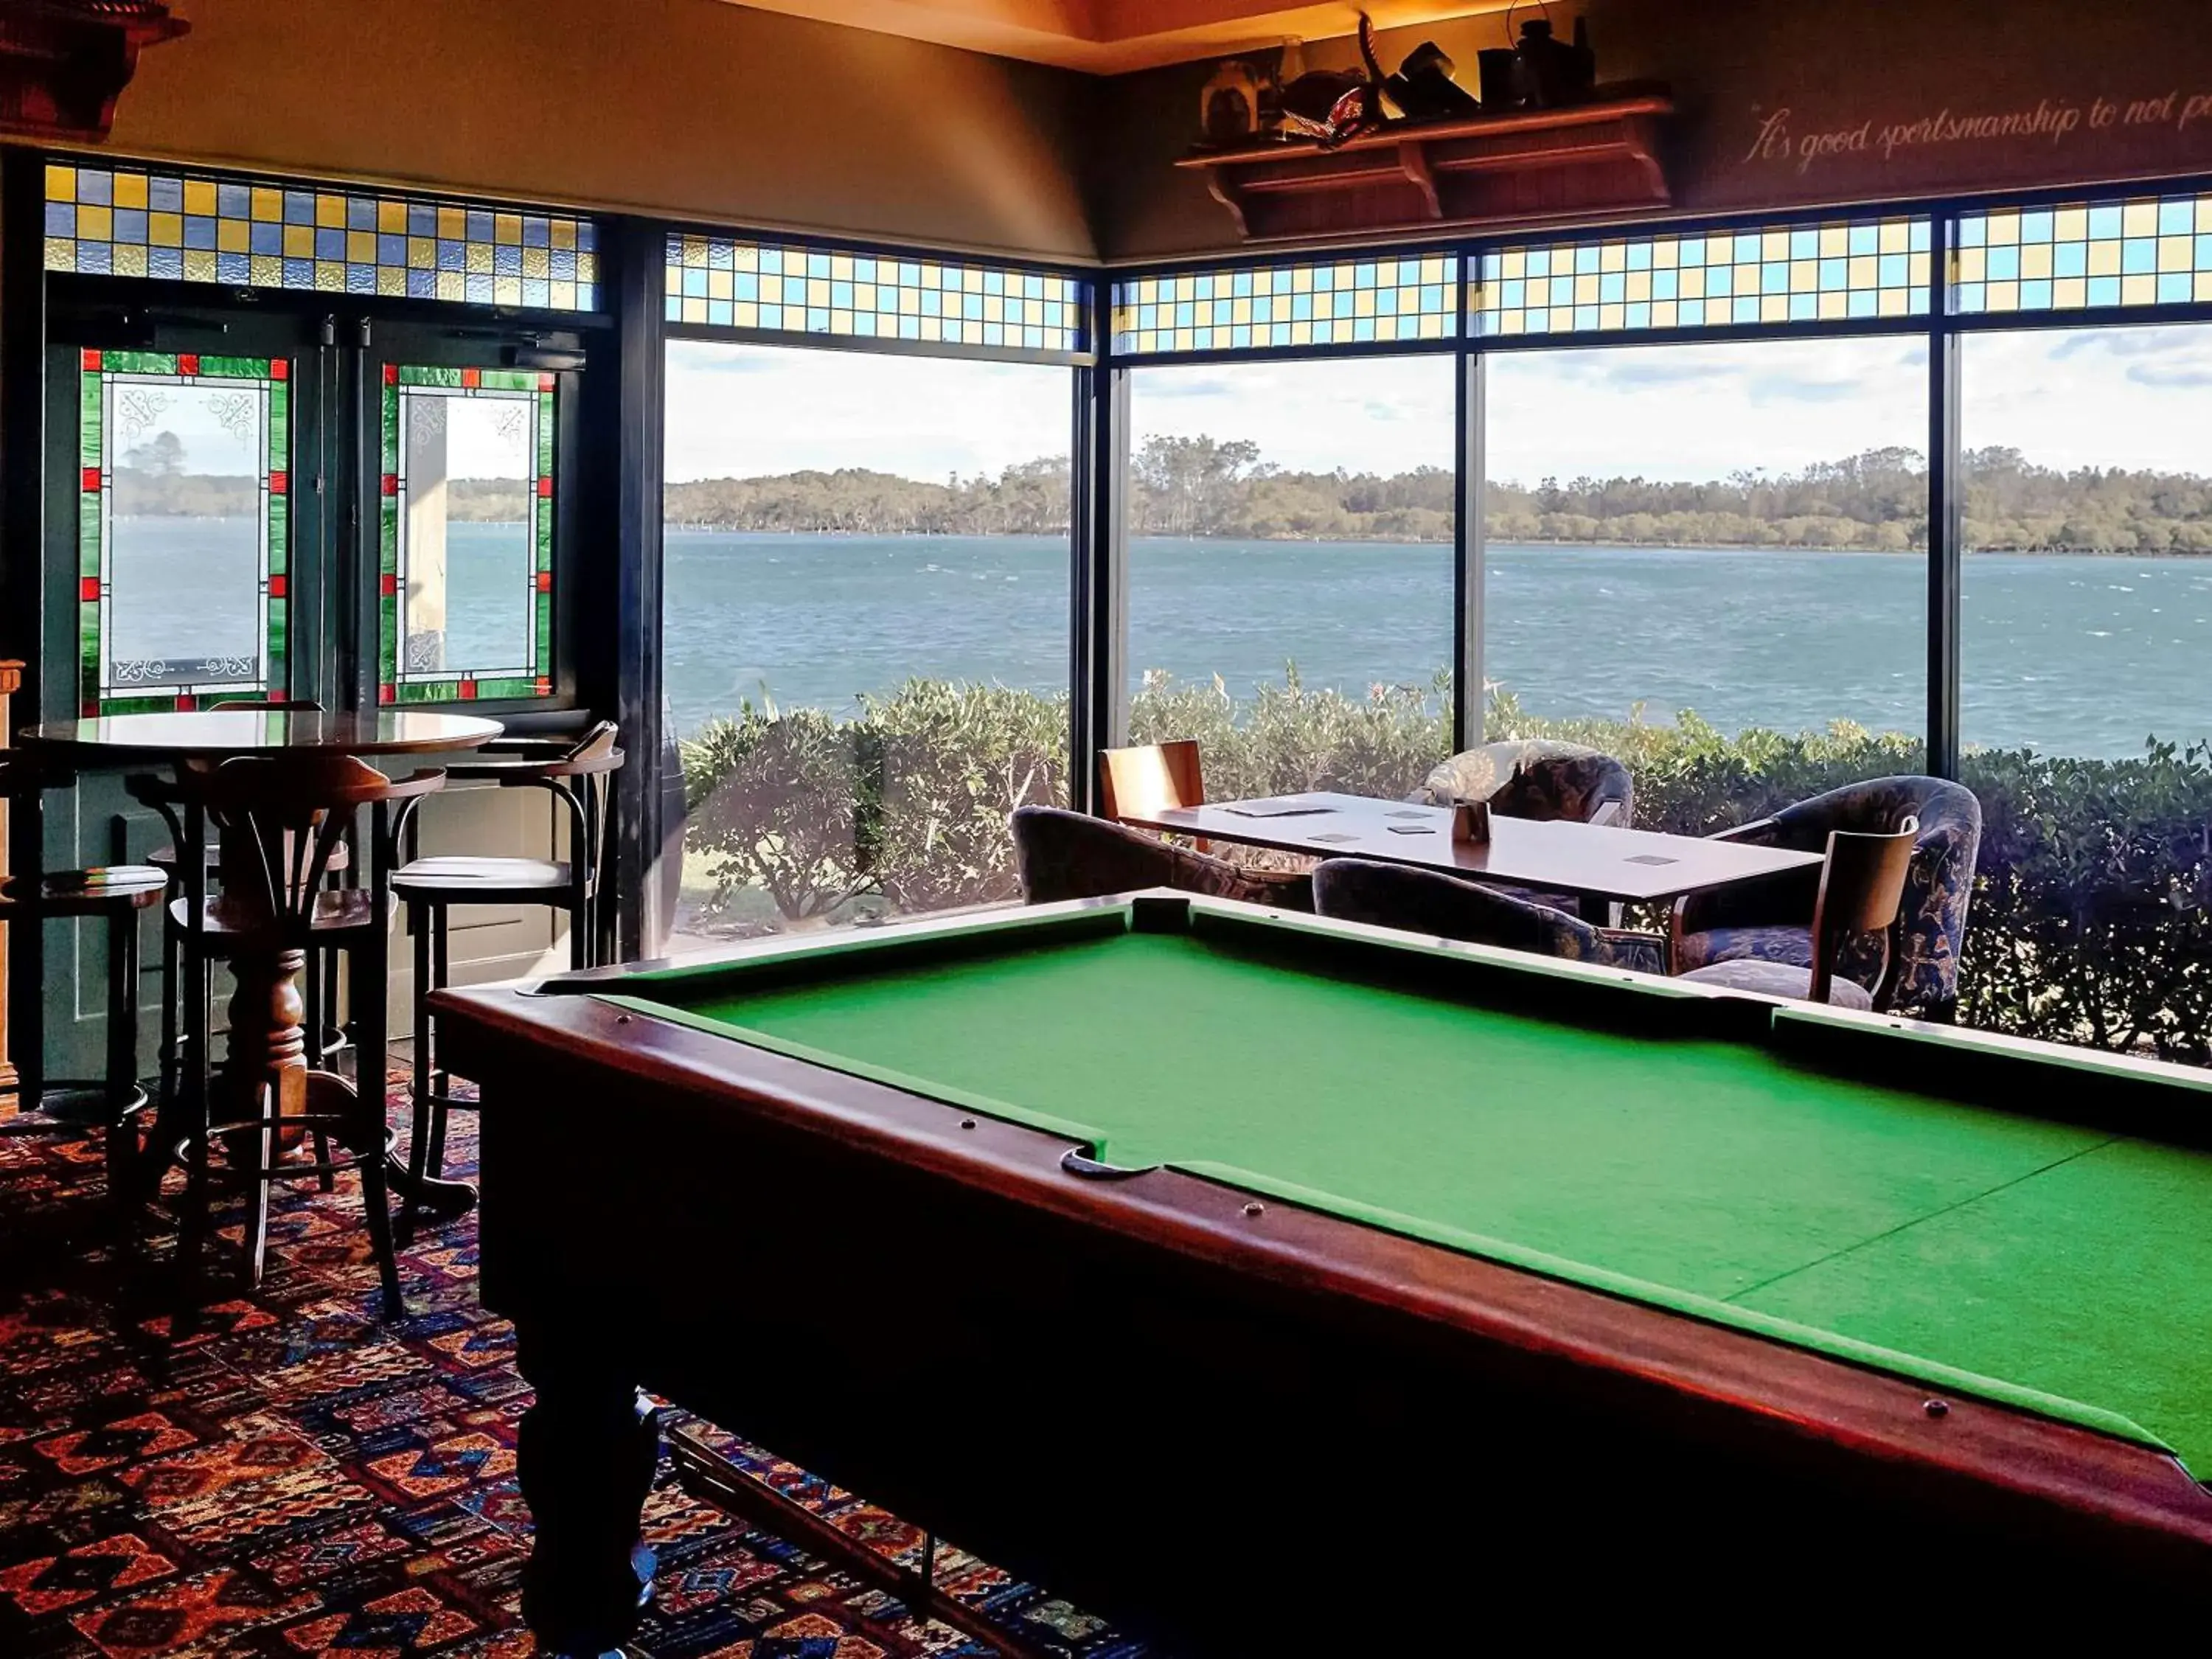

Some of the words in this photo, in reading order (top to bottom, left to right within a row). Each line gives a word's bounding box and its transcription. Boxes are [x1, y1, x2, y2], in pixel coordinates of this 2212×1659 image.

[1798, 119, 1872, 175] good
[1877, 99, 2080, 159] sportsmanship
[2089, 96, 2117, 128] to
[2124, 88, 2179, 124] not
